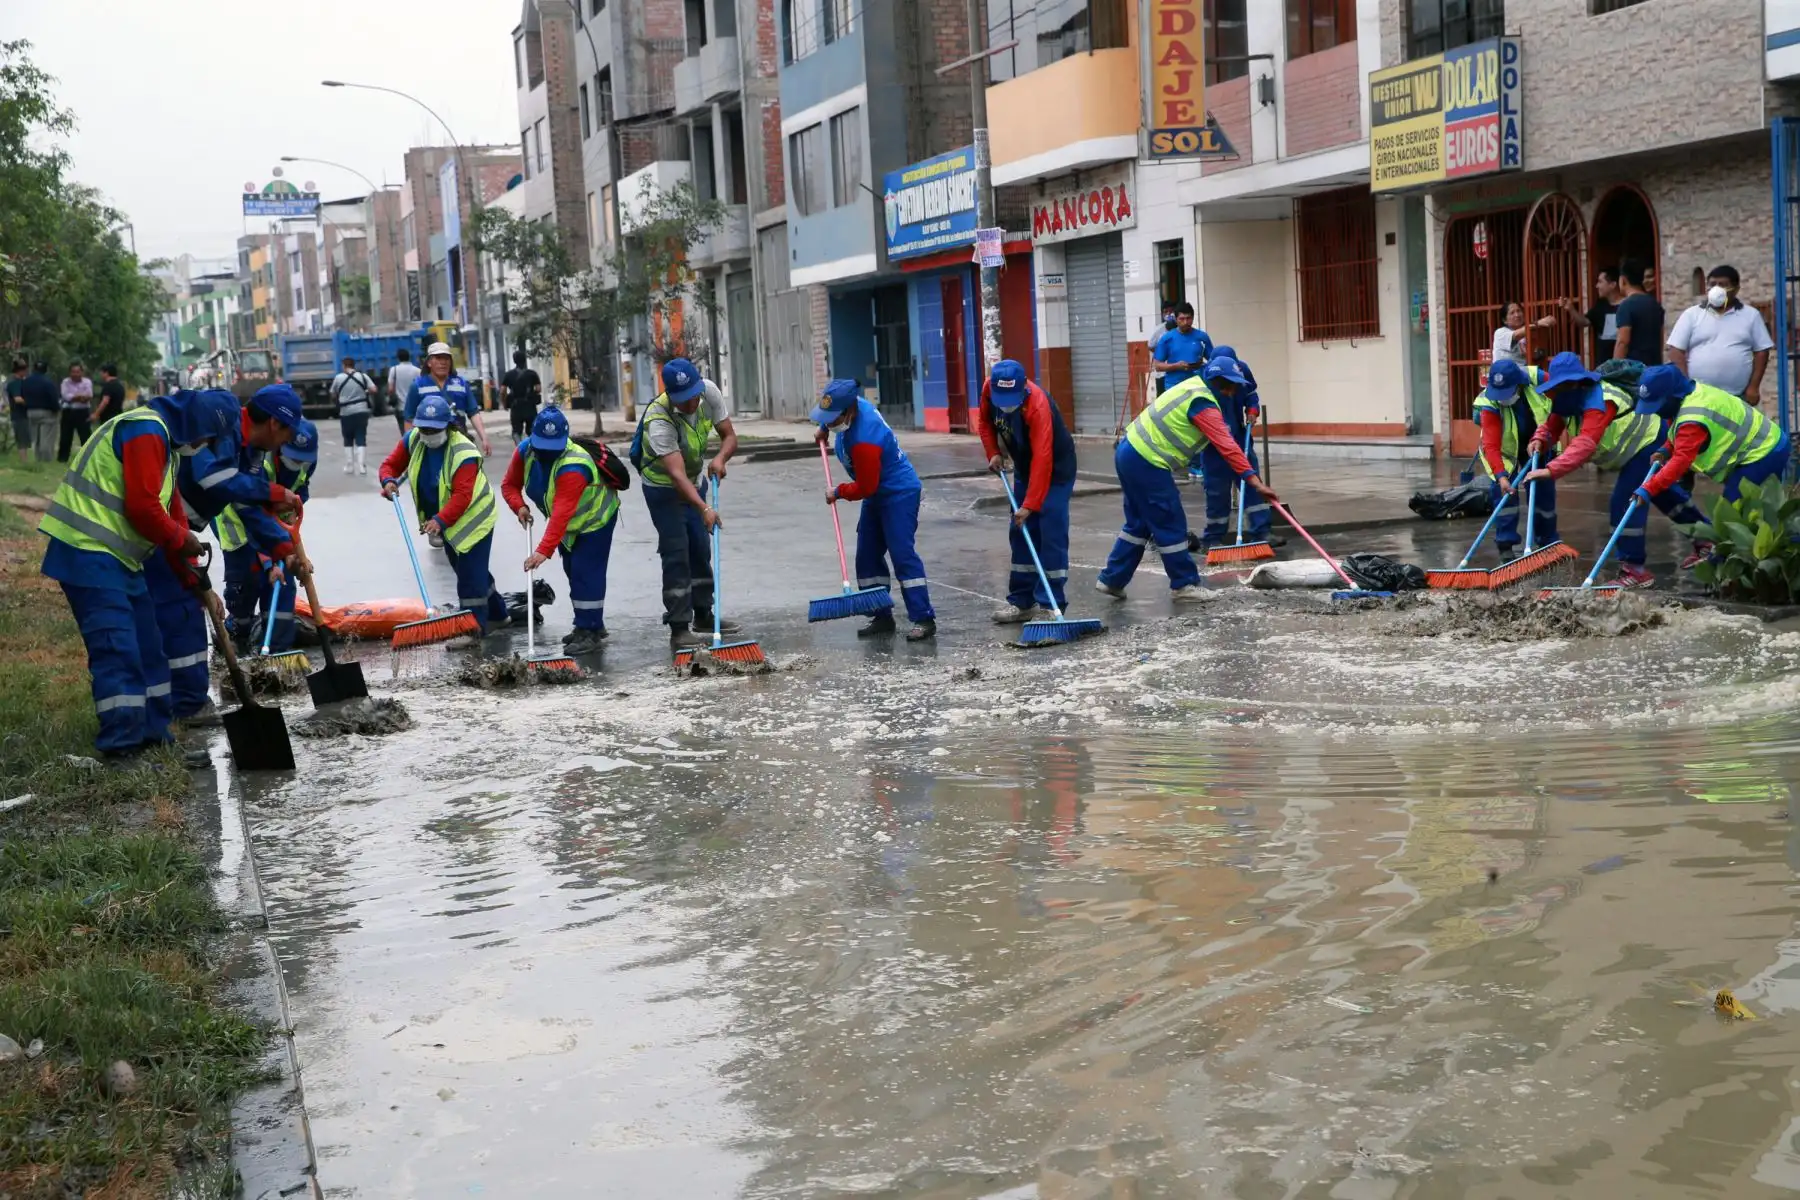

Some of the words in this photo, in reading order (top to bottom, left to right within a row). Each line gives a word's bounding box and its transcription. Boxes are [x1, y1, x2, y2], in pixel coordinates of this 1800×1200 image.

[1157, 0, 1199, 125] DAJE
[1372, 77, 1411, 103] WESTERN
[1414, 70, 1440, 111] WU
[1444, 49, 1499, 112] DOLAR
[1384, 95, 1412, 119] UNION
[1502, 42, 1519, 165] DOLAR
[1152, 130, 1222, 153] SOL
[1374, 136, 1395, 150] PAGOS
[1395, 134, 1404, 147] DE
[1405, 127, 1440, 145] SERVICIOS
[1445, 122, 1499, 169] EUROS
[1376, 151, 1396, 165] GIROS
[1397, 143, 1437, 161] NACIONALES
[1375, 169, 1380, 181] E
[1381, 158, 1440, 179] INTERNACIONALES
[1032, 182, 1131, 239] MANCORA
[1047, 277, 1062, 285] VISA
